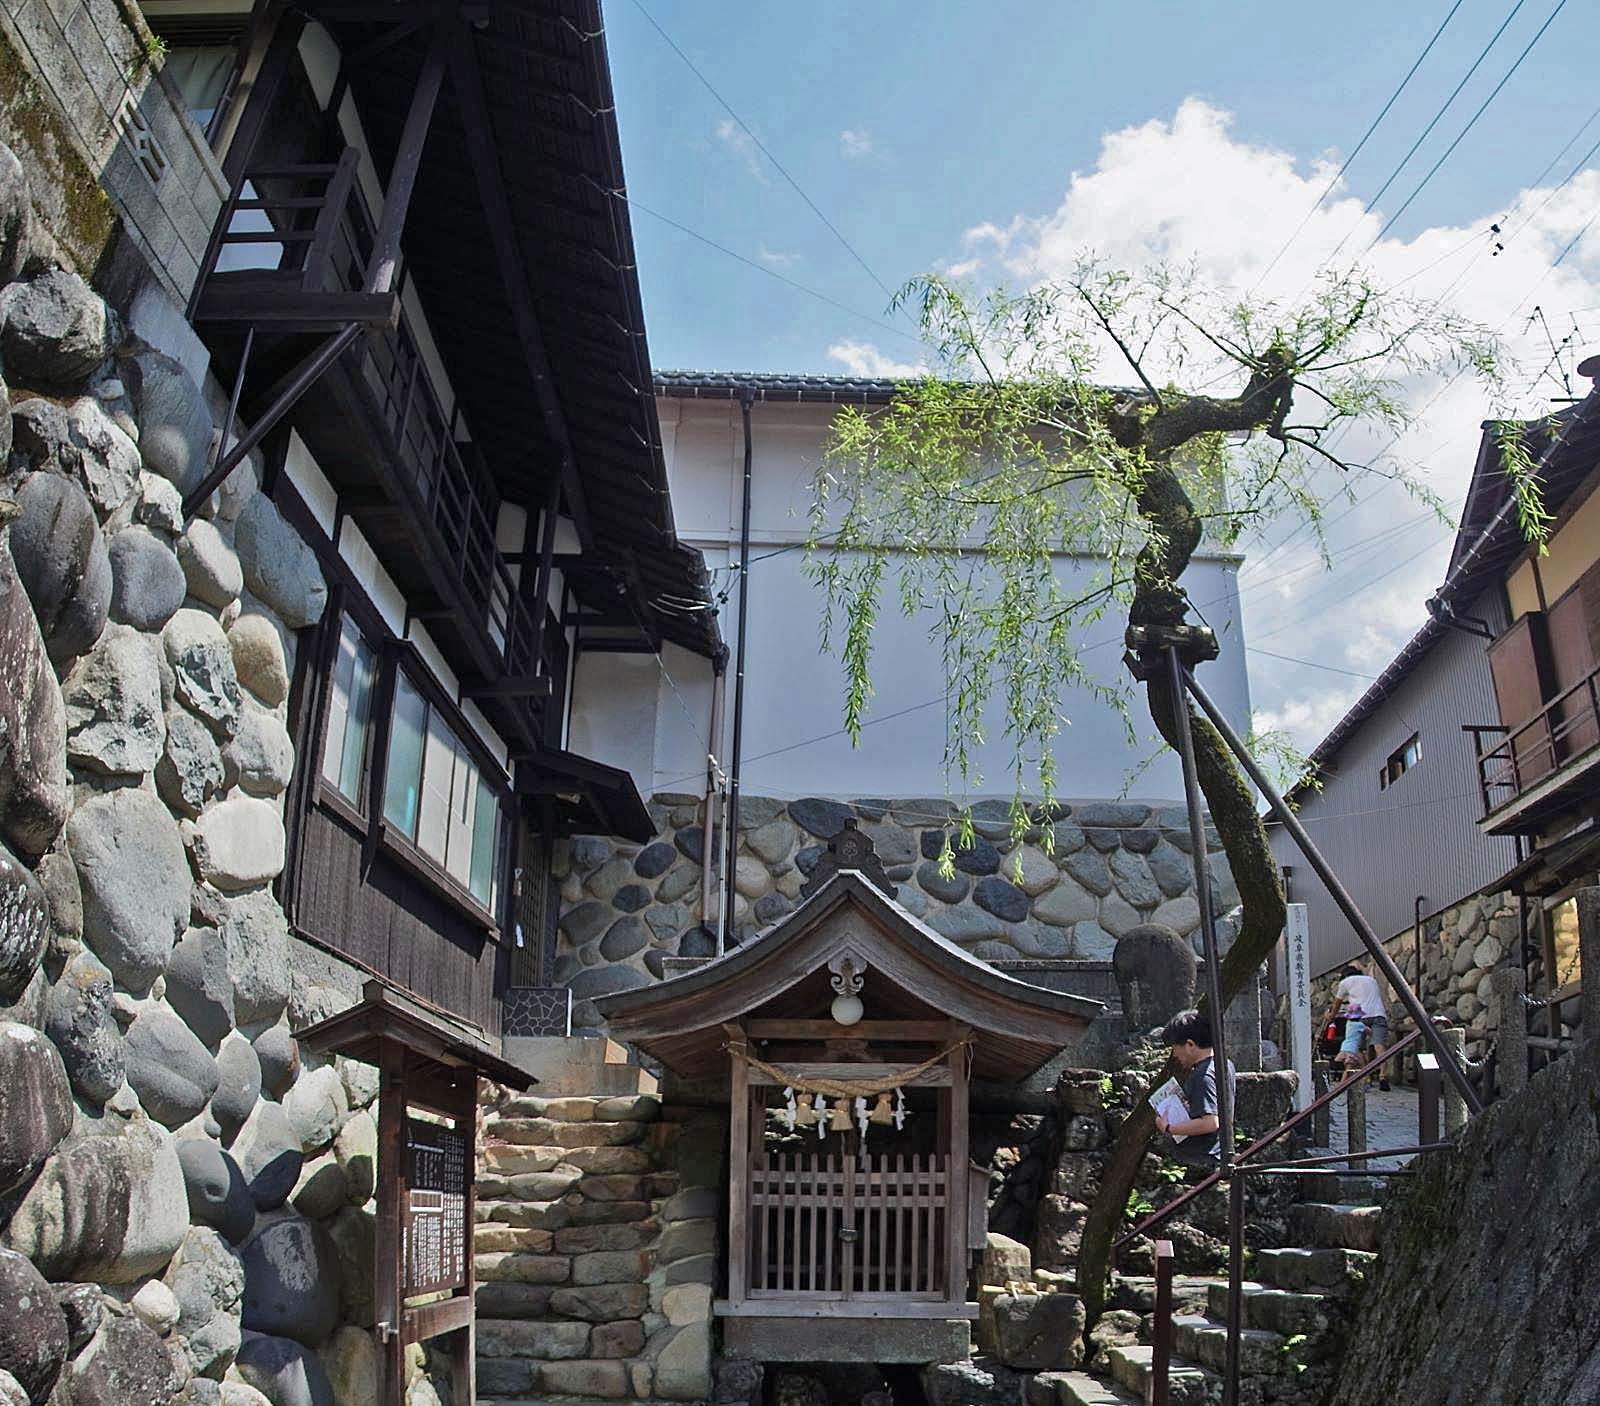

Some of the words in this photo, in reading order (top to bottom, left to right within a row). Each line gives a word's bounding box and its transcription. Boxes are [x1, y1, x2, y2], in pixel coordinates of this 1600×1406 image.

[1294, 934, 1307, 1007] 岐阜県教育委員会
